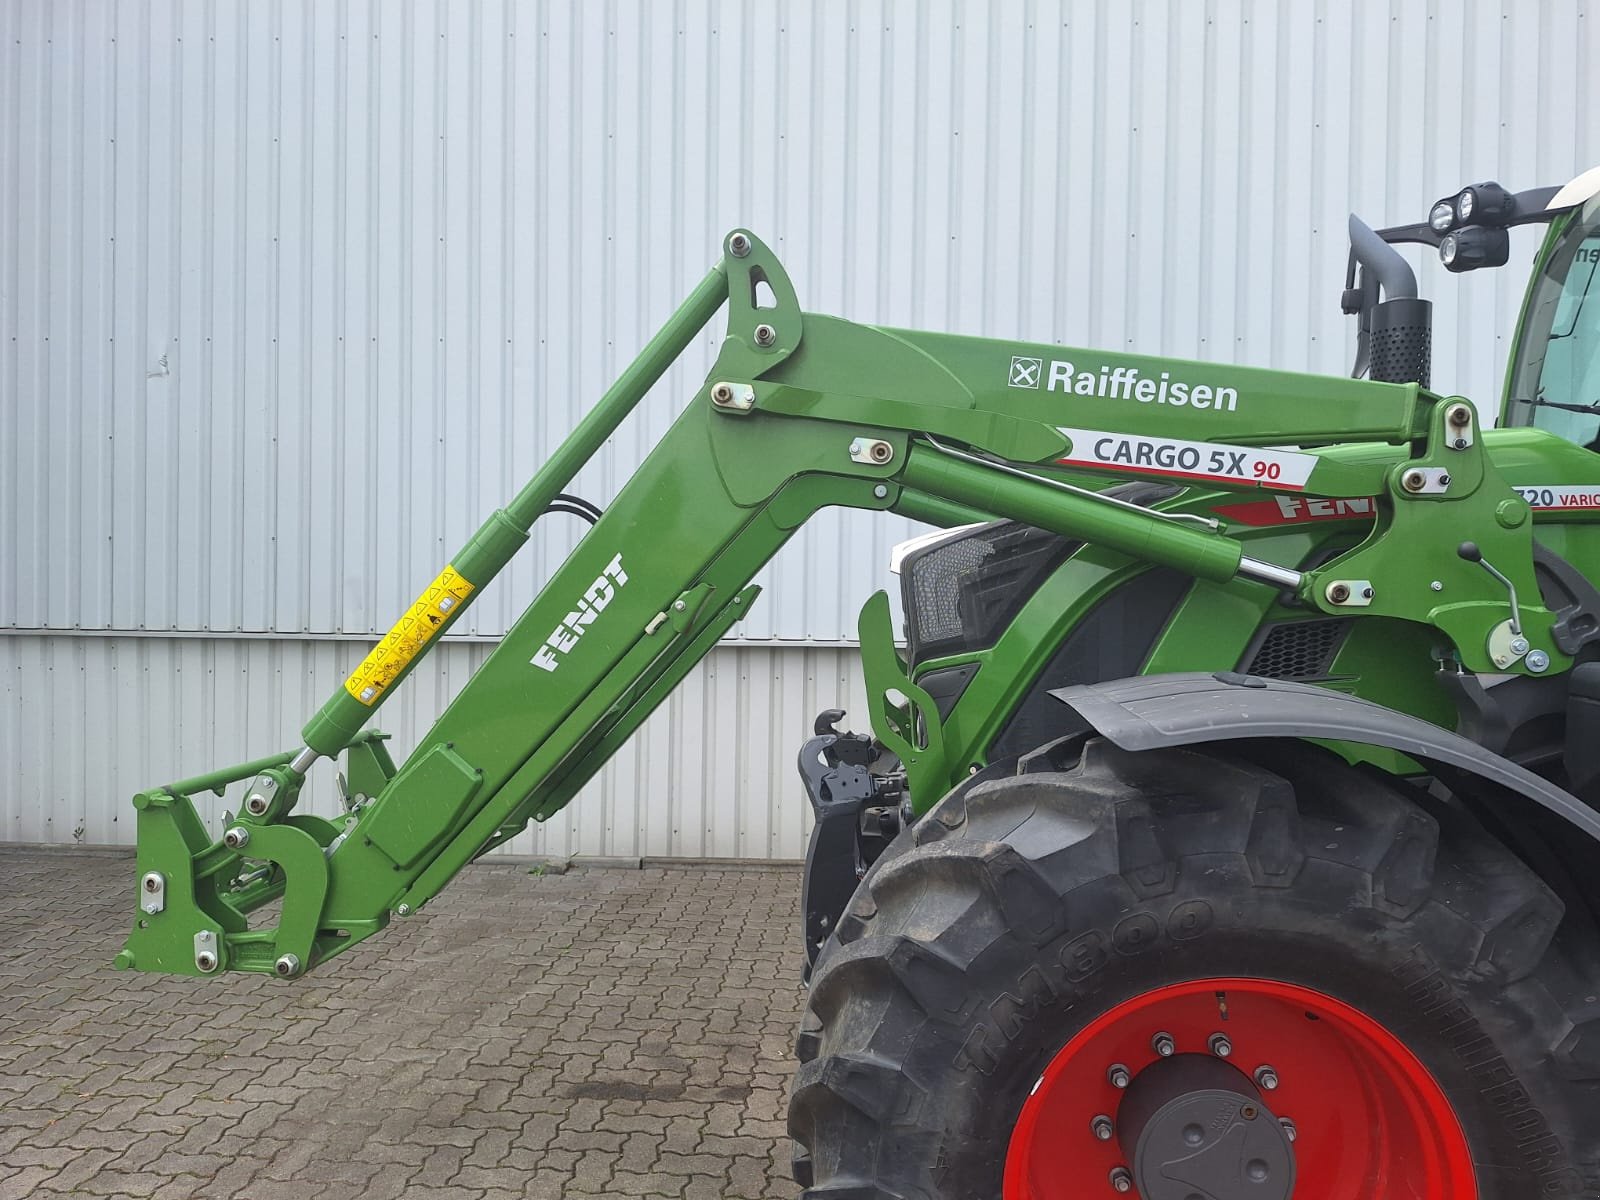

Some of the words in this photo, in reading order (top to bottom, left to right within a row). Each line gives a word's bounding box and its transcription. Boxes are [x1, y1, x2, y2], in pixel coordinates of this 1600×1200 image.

[1047, 360, 1238, 411] Raiffeisen
[1093, 437, 1200, 470] CARGO
[1207, 451, 1247, 476] 5X
[1253, 461, 1281, 480] 90
[1275, 495, 1377, 519] FEN
[529, 552, 629, 673] FENDT
[952, 898, 1213, 1076] TM800
